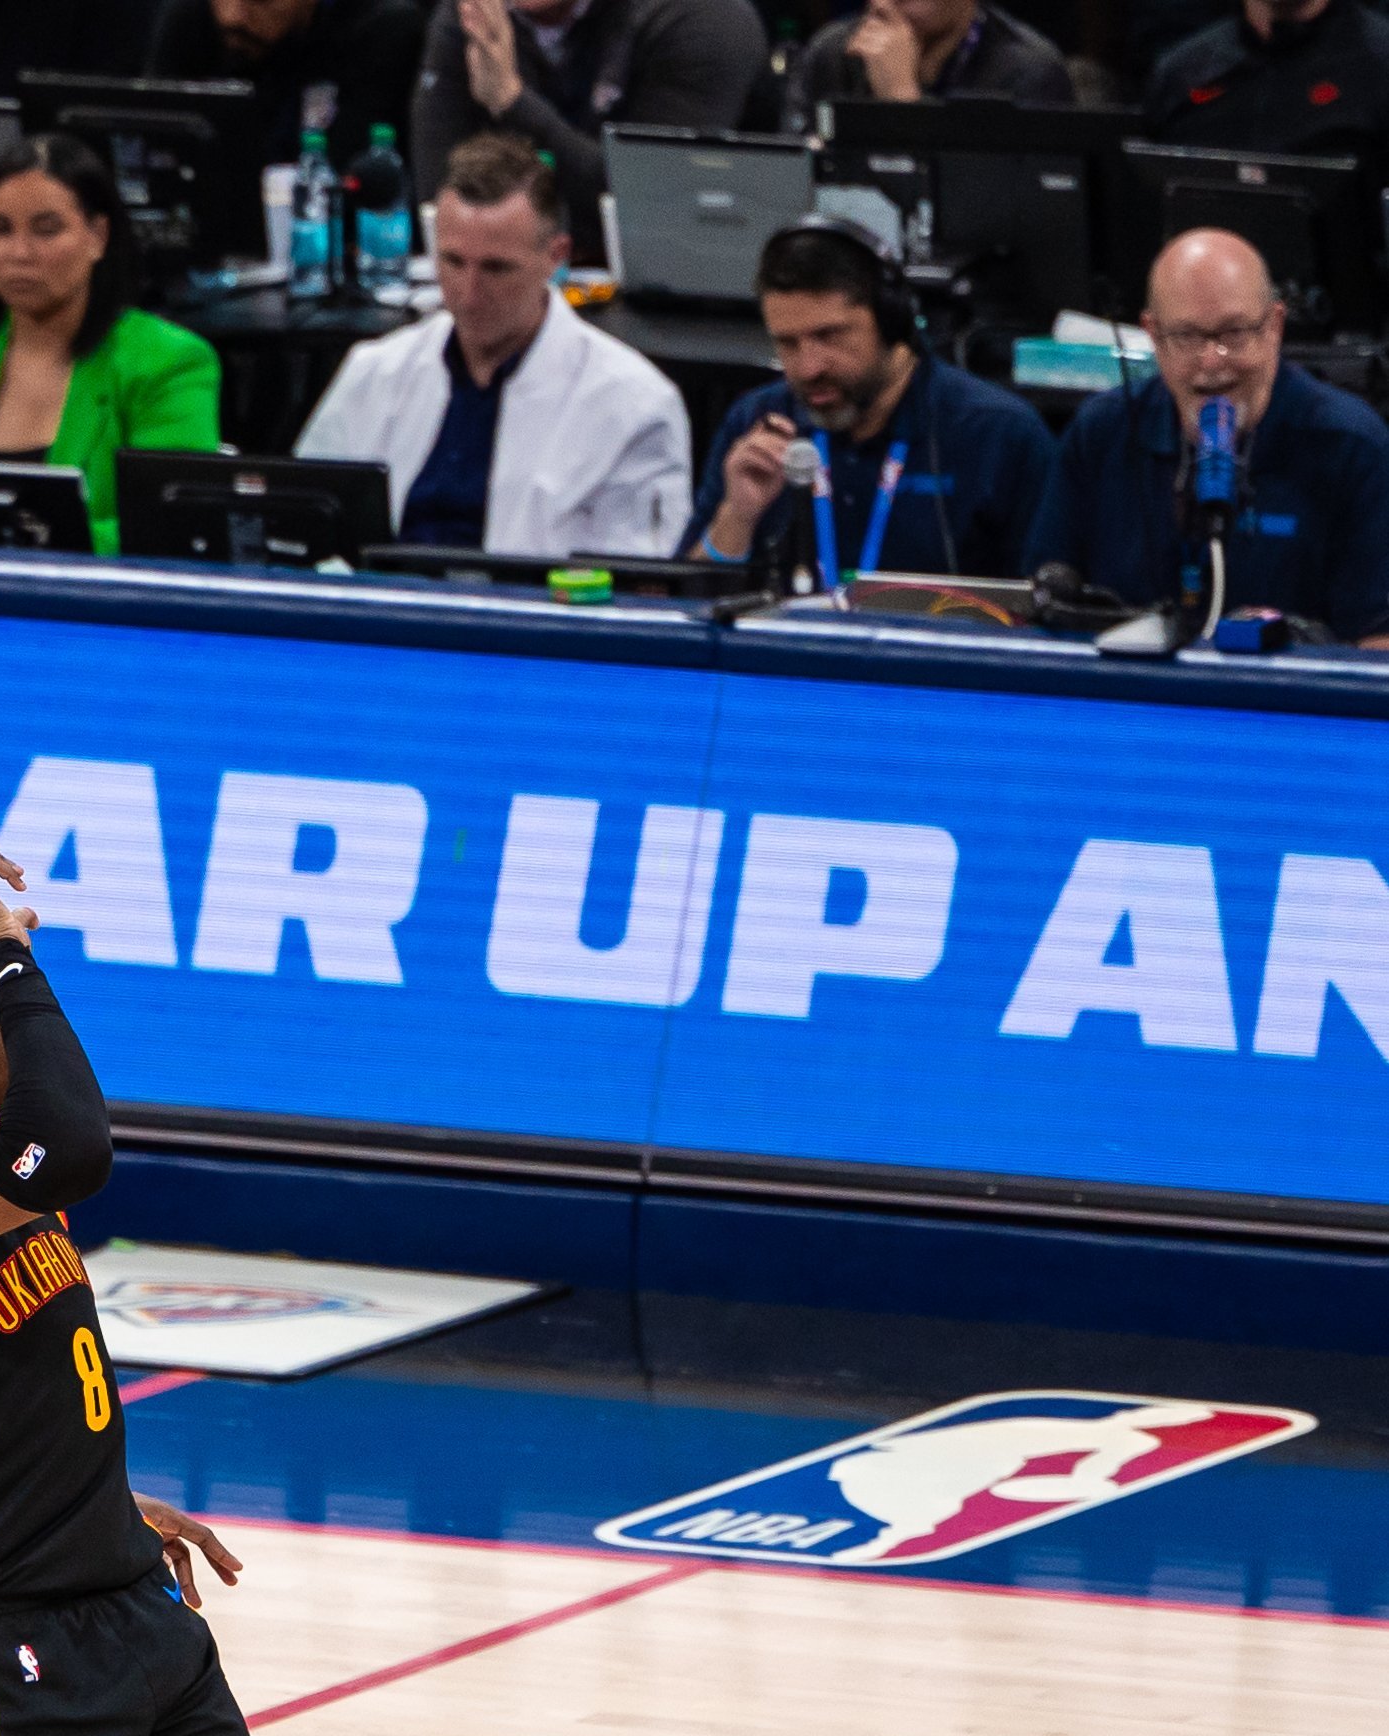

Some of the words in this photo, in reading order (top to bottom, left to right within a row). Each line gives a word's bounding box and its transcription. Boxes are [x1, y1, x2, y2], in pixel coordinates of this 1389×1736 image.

[485, 793, 958, 1021] UP
[73, 1327, 111, 1432] 8
[652, 1508, 855, 1549] NBA
